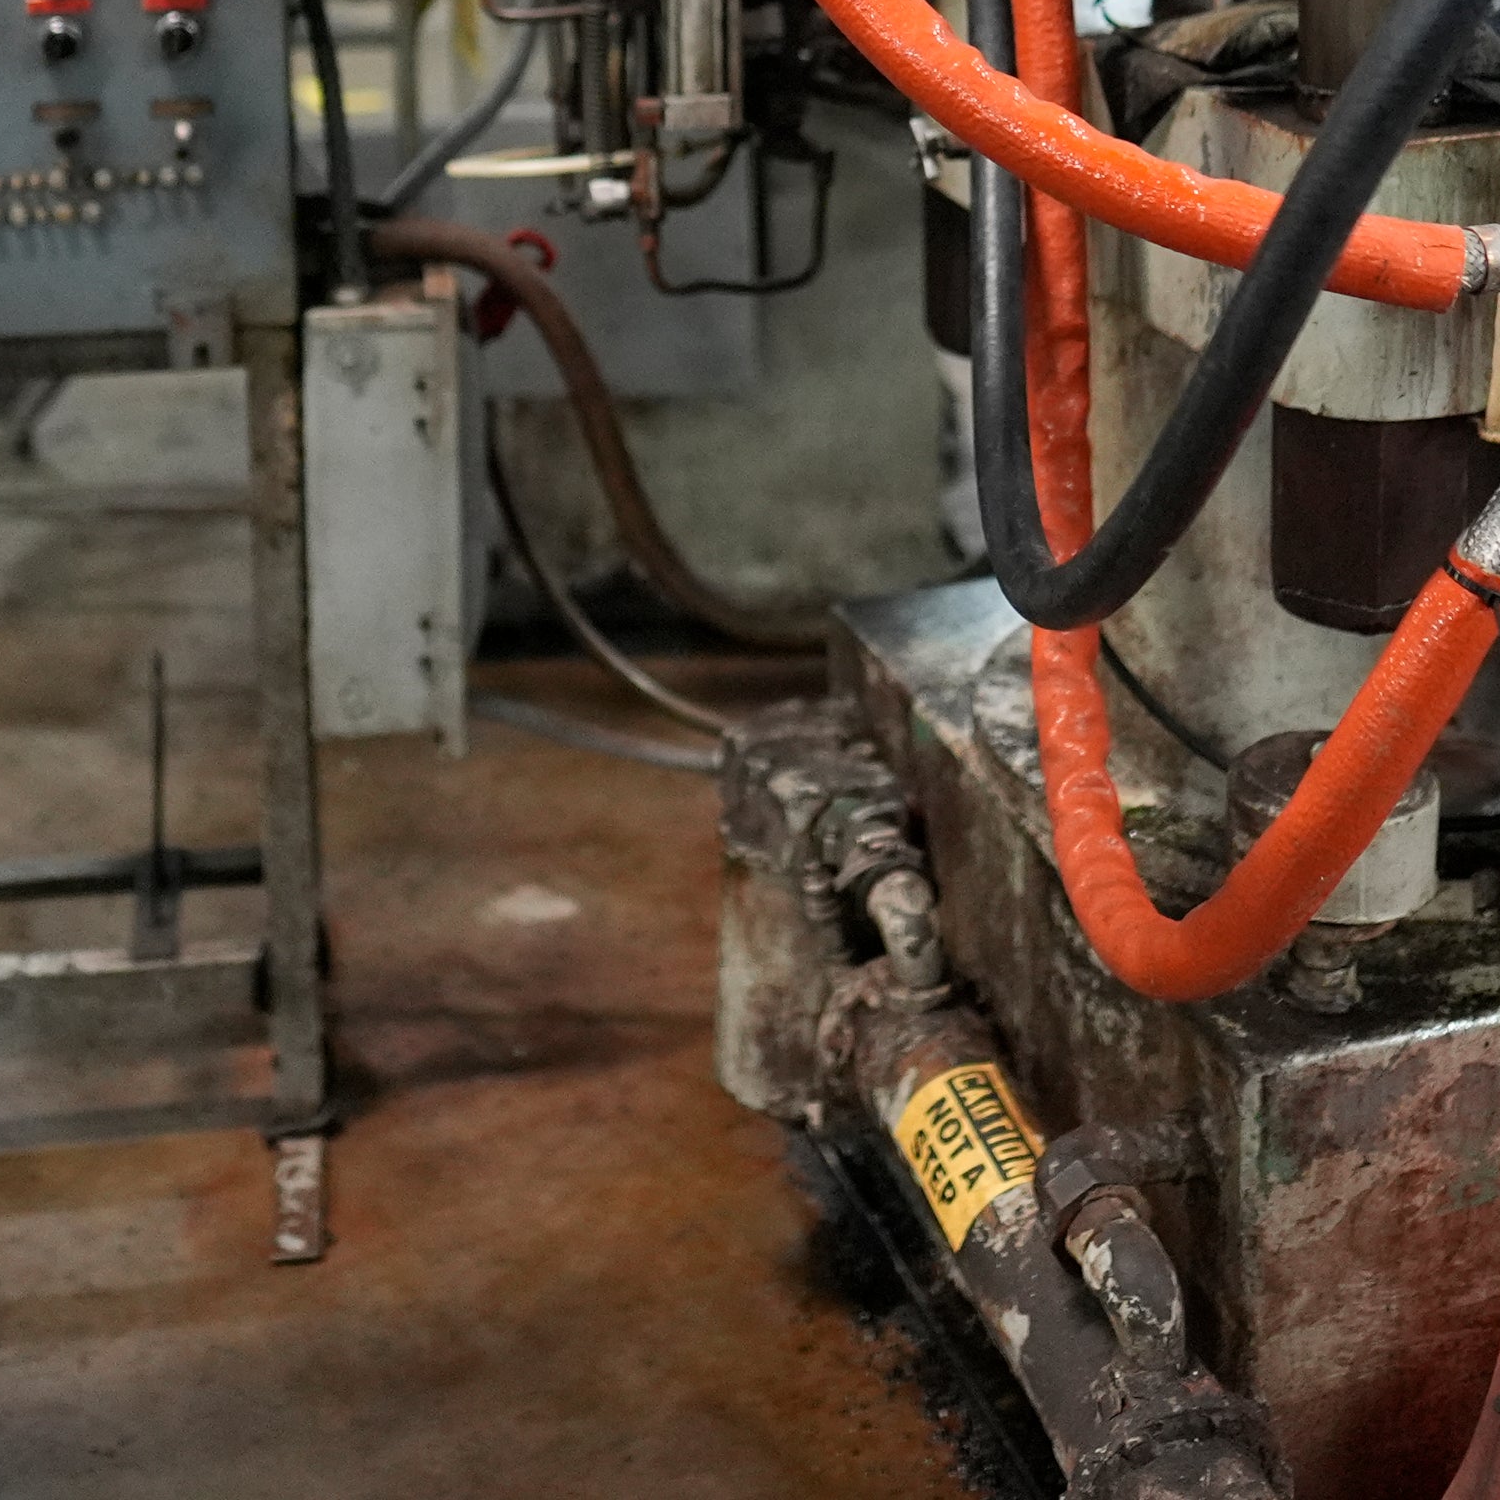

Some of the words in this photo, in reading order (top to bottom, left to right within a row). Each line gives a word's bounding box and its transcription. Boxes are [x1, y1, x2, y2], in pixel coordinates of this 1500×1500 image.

[911, 1129, 957, 1205] STEP
[925, 1097, 974, 1161] NOT
[960, 1164, 986, 1192] A
[950, 1071, 1037, 1180] CAUTION
